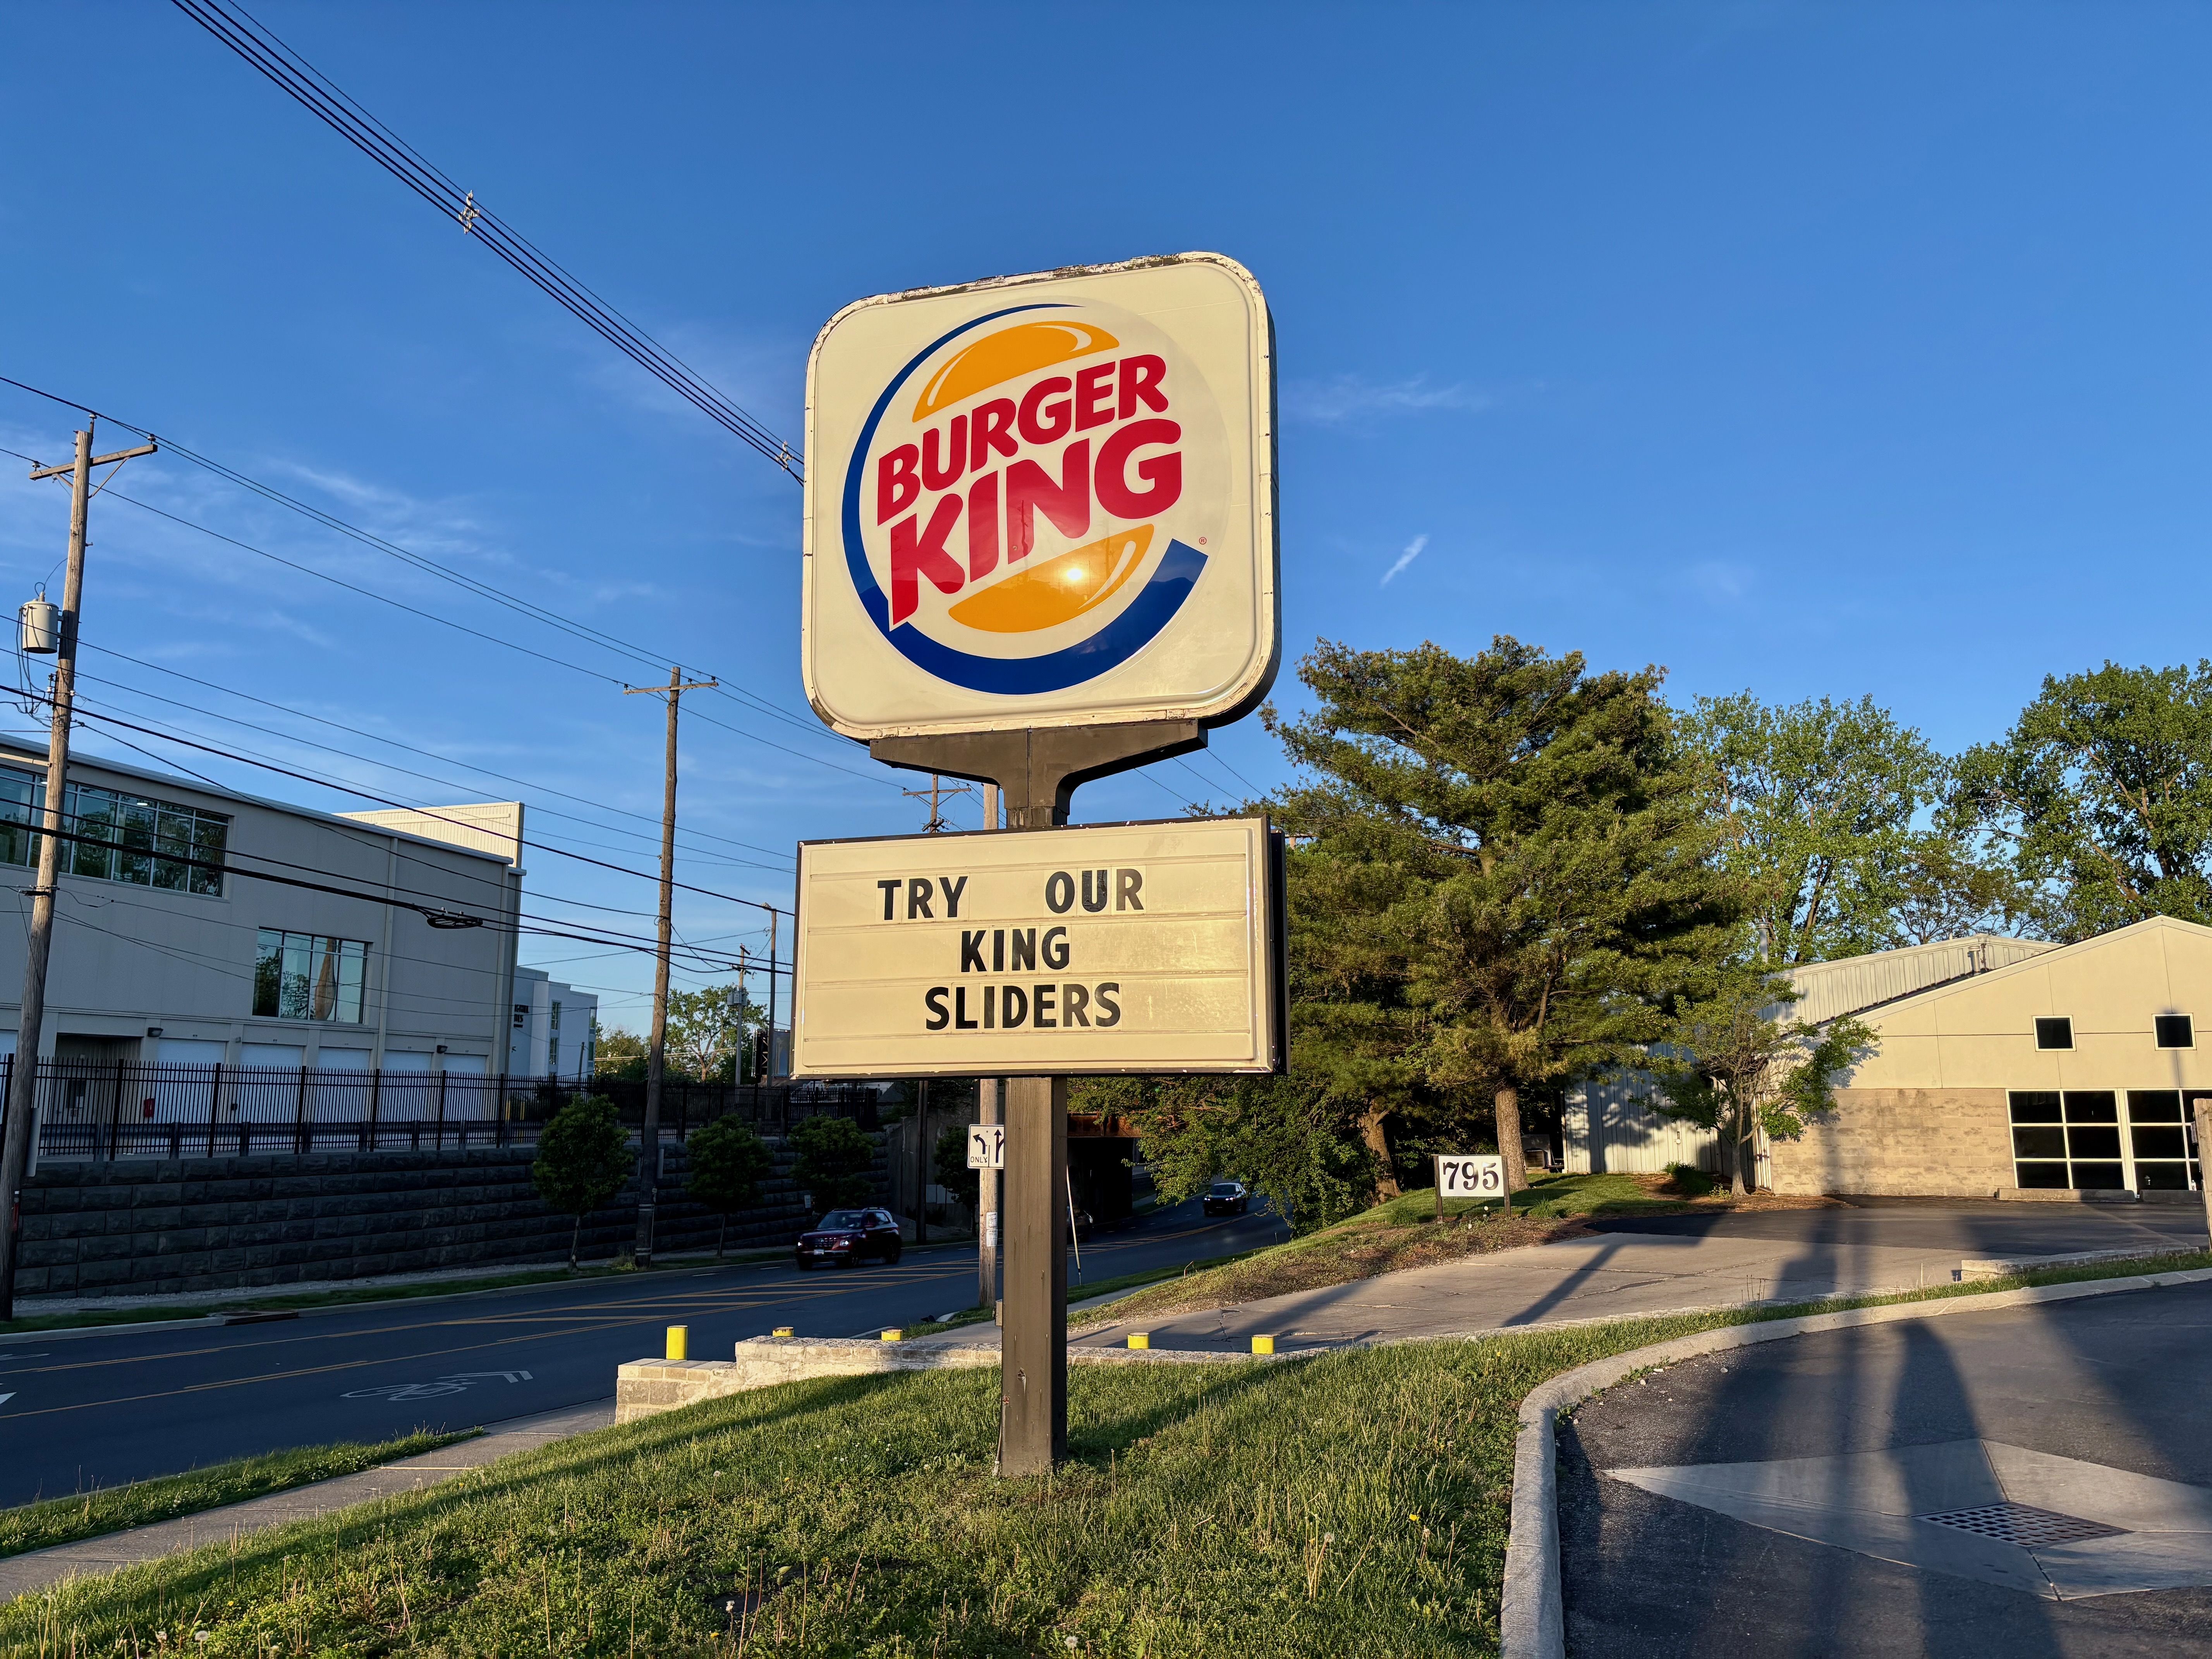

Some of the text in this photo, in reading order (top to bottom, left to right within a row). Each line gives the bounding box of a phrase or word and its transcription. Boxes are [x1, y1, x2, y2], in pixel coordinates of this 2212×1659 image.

[877, 354, 1169, 526] BURGER
[890, 418, 1182, 626] KING
[877, 868, 1144, 921] TRY OUR
[961, 926, 1070, 973] KING
[925, 982, 1121, 1030] SLIDERS
[1443, 1161, 1499, 1190] 795
